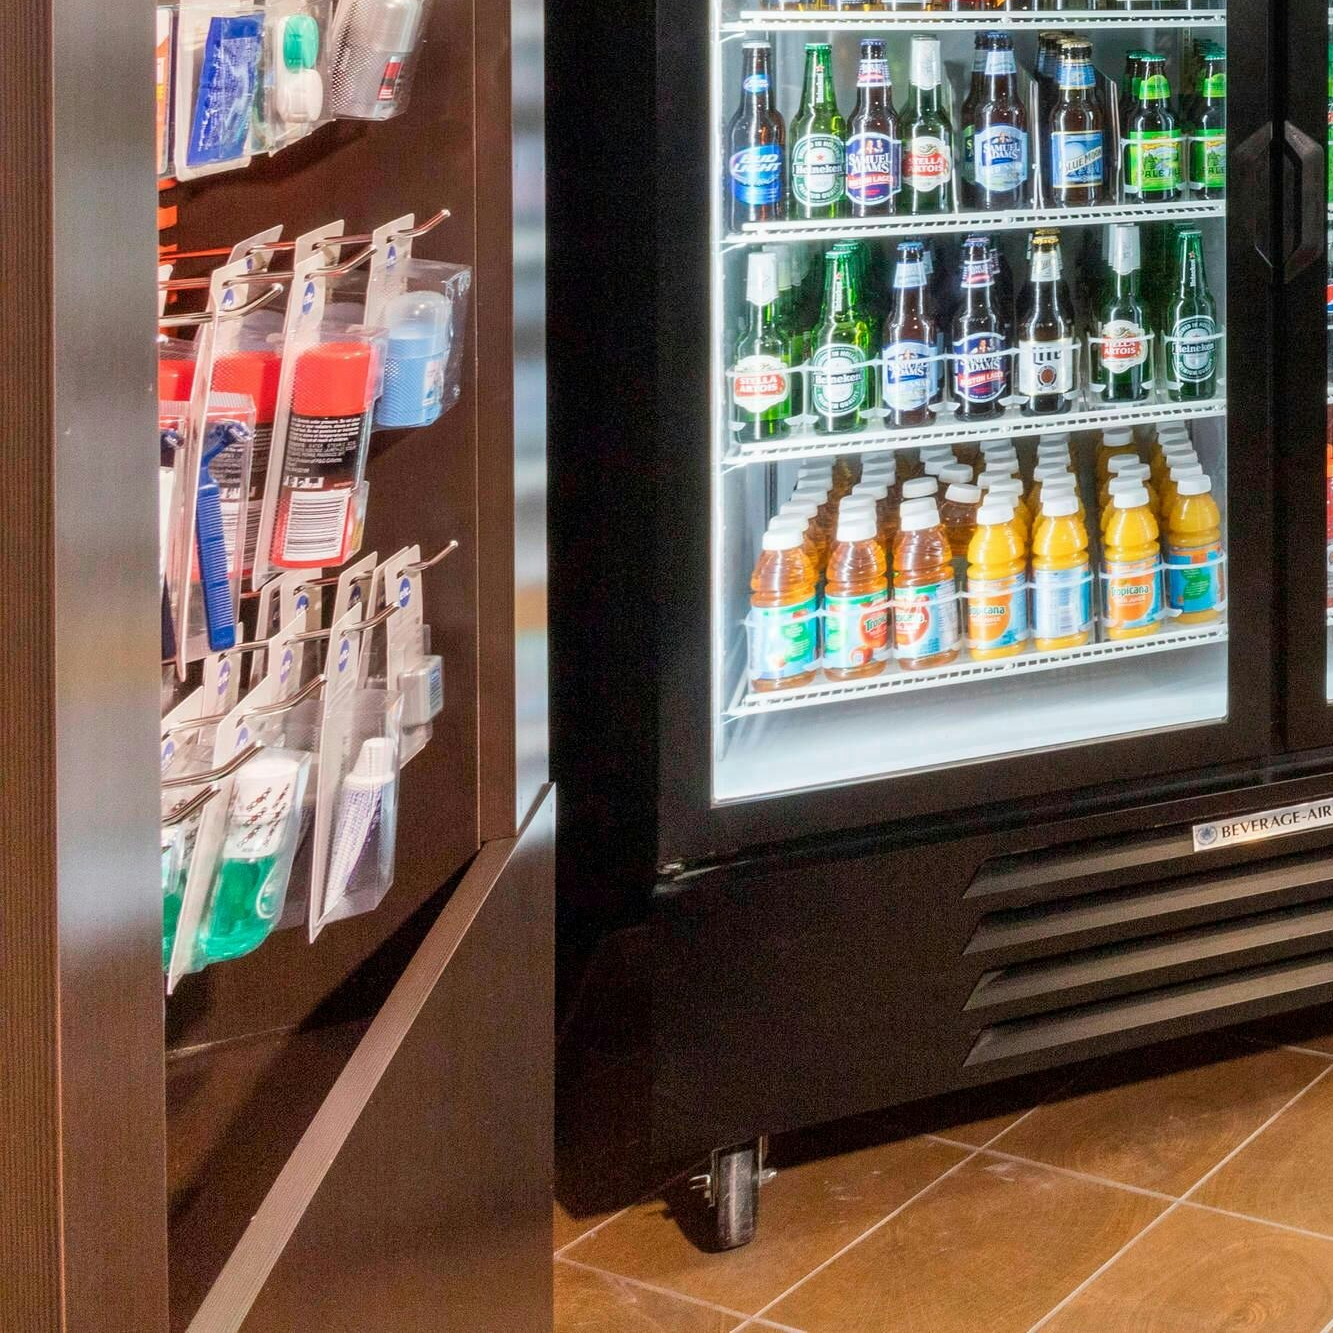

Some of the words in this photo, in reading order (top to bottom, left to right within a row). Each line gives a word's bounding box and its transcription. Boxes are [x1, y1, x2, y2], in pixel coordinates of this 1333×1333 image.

[983, 143, 1021, 154] SAMUEL
[740, 154, 779, 163] BUD
[849, 153, 891, 165] SAMUEL
[795, 164, 844, 175] Heineken
[1104, 346, 1136, 356] ARTOIS
[1175, 343, 1215, 354] Heineken
[739, 375, 777, 384] STELLA
[816, 374, 862, 385] Heineken
[739, 383, 777, 393] ARTOIS
[1111, 584, 1149, 597] Tropicana
[1221, 804, 1333, 839] BEVERAGE-AIR
